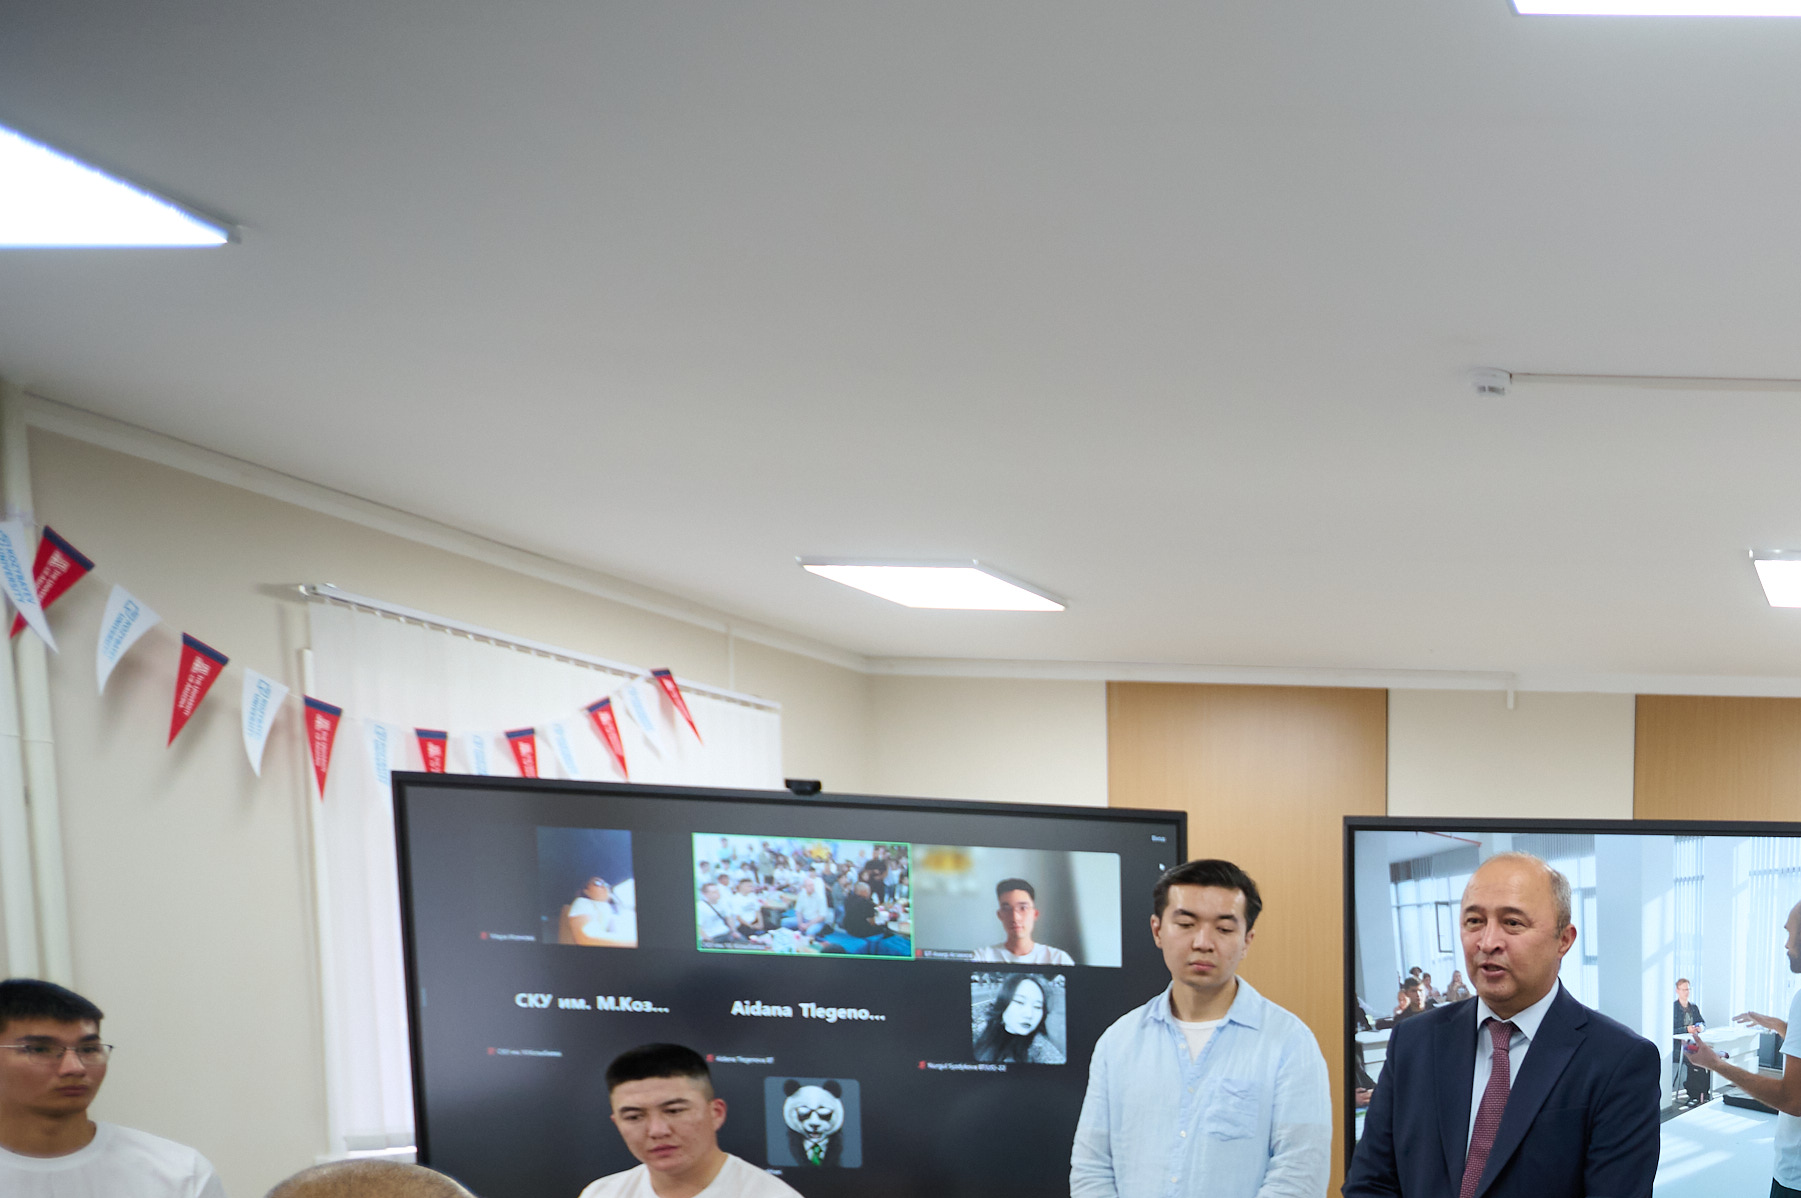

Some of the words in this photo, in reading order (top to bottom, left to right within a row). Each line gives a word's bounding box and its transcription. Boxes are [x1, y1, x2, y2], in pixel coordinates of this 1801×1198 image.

[514, 993, 553, 1009] СКУ
[558, 997, 591, 1010] им.
[730, 1000, 793, 1018] Aidana
[798, 1002, 886, 1023] Tlegeno...
